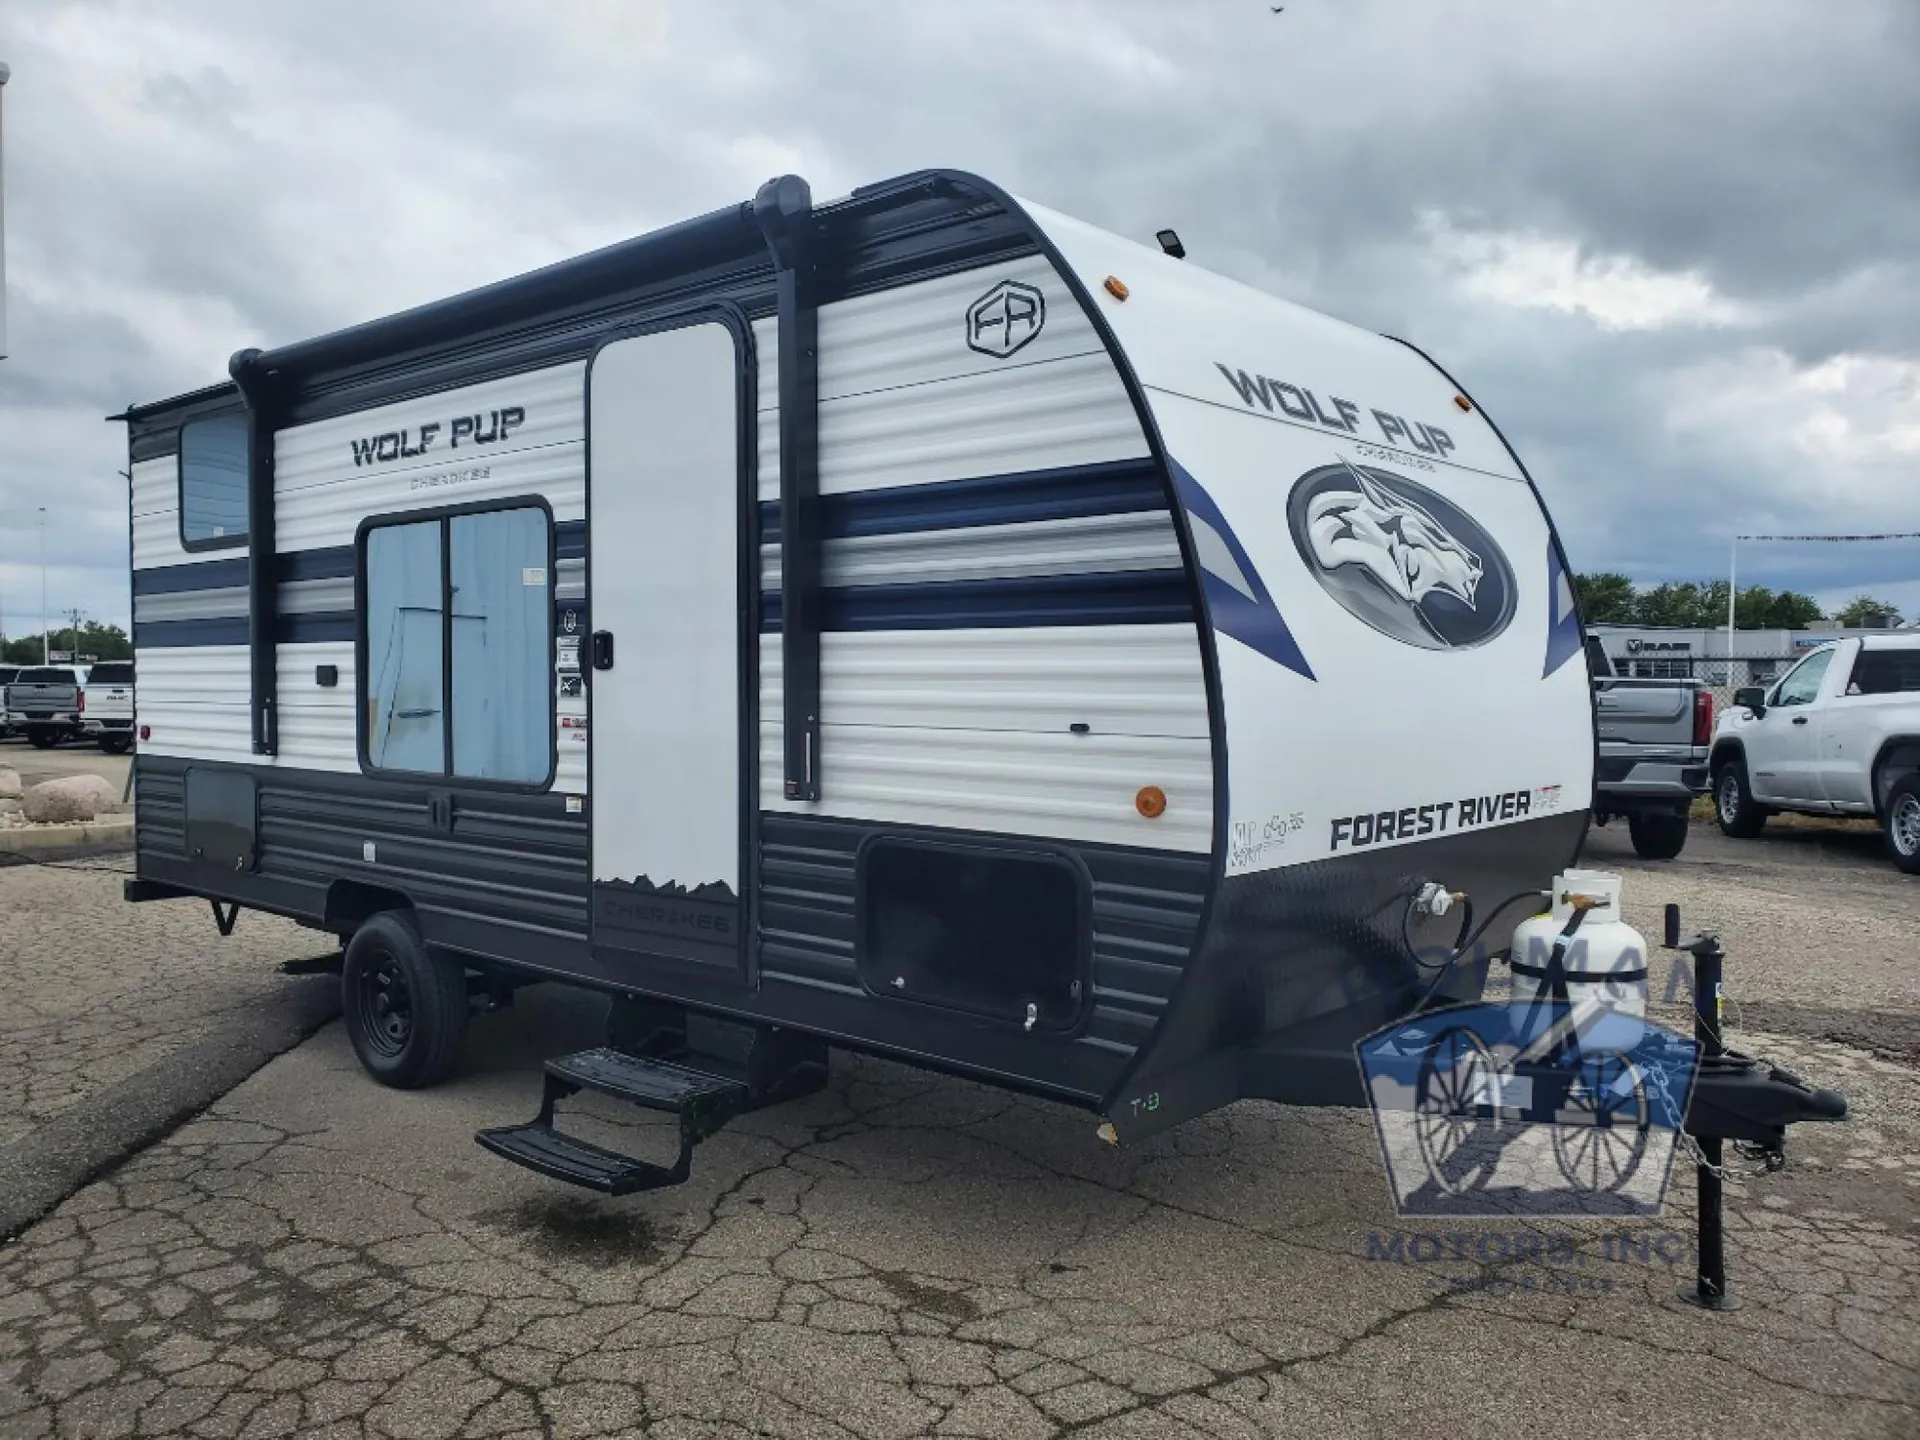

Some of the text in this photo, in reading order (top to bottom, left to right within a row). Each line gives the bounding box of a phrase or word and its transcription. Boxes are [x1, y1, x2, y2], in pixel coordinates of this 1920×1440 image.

[350, 406, 526, 467] WOLF PUP
[1213, 361, 1456, 458] WOLF PUP
[1330, 802, 1453, 850] FOREST
[1458, 789, 1531, 827] RIVER
